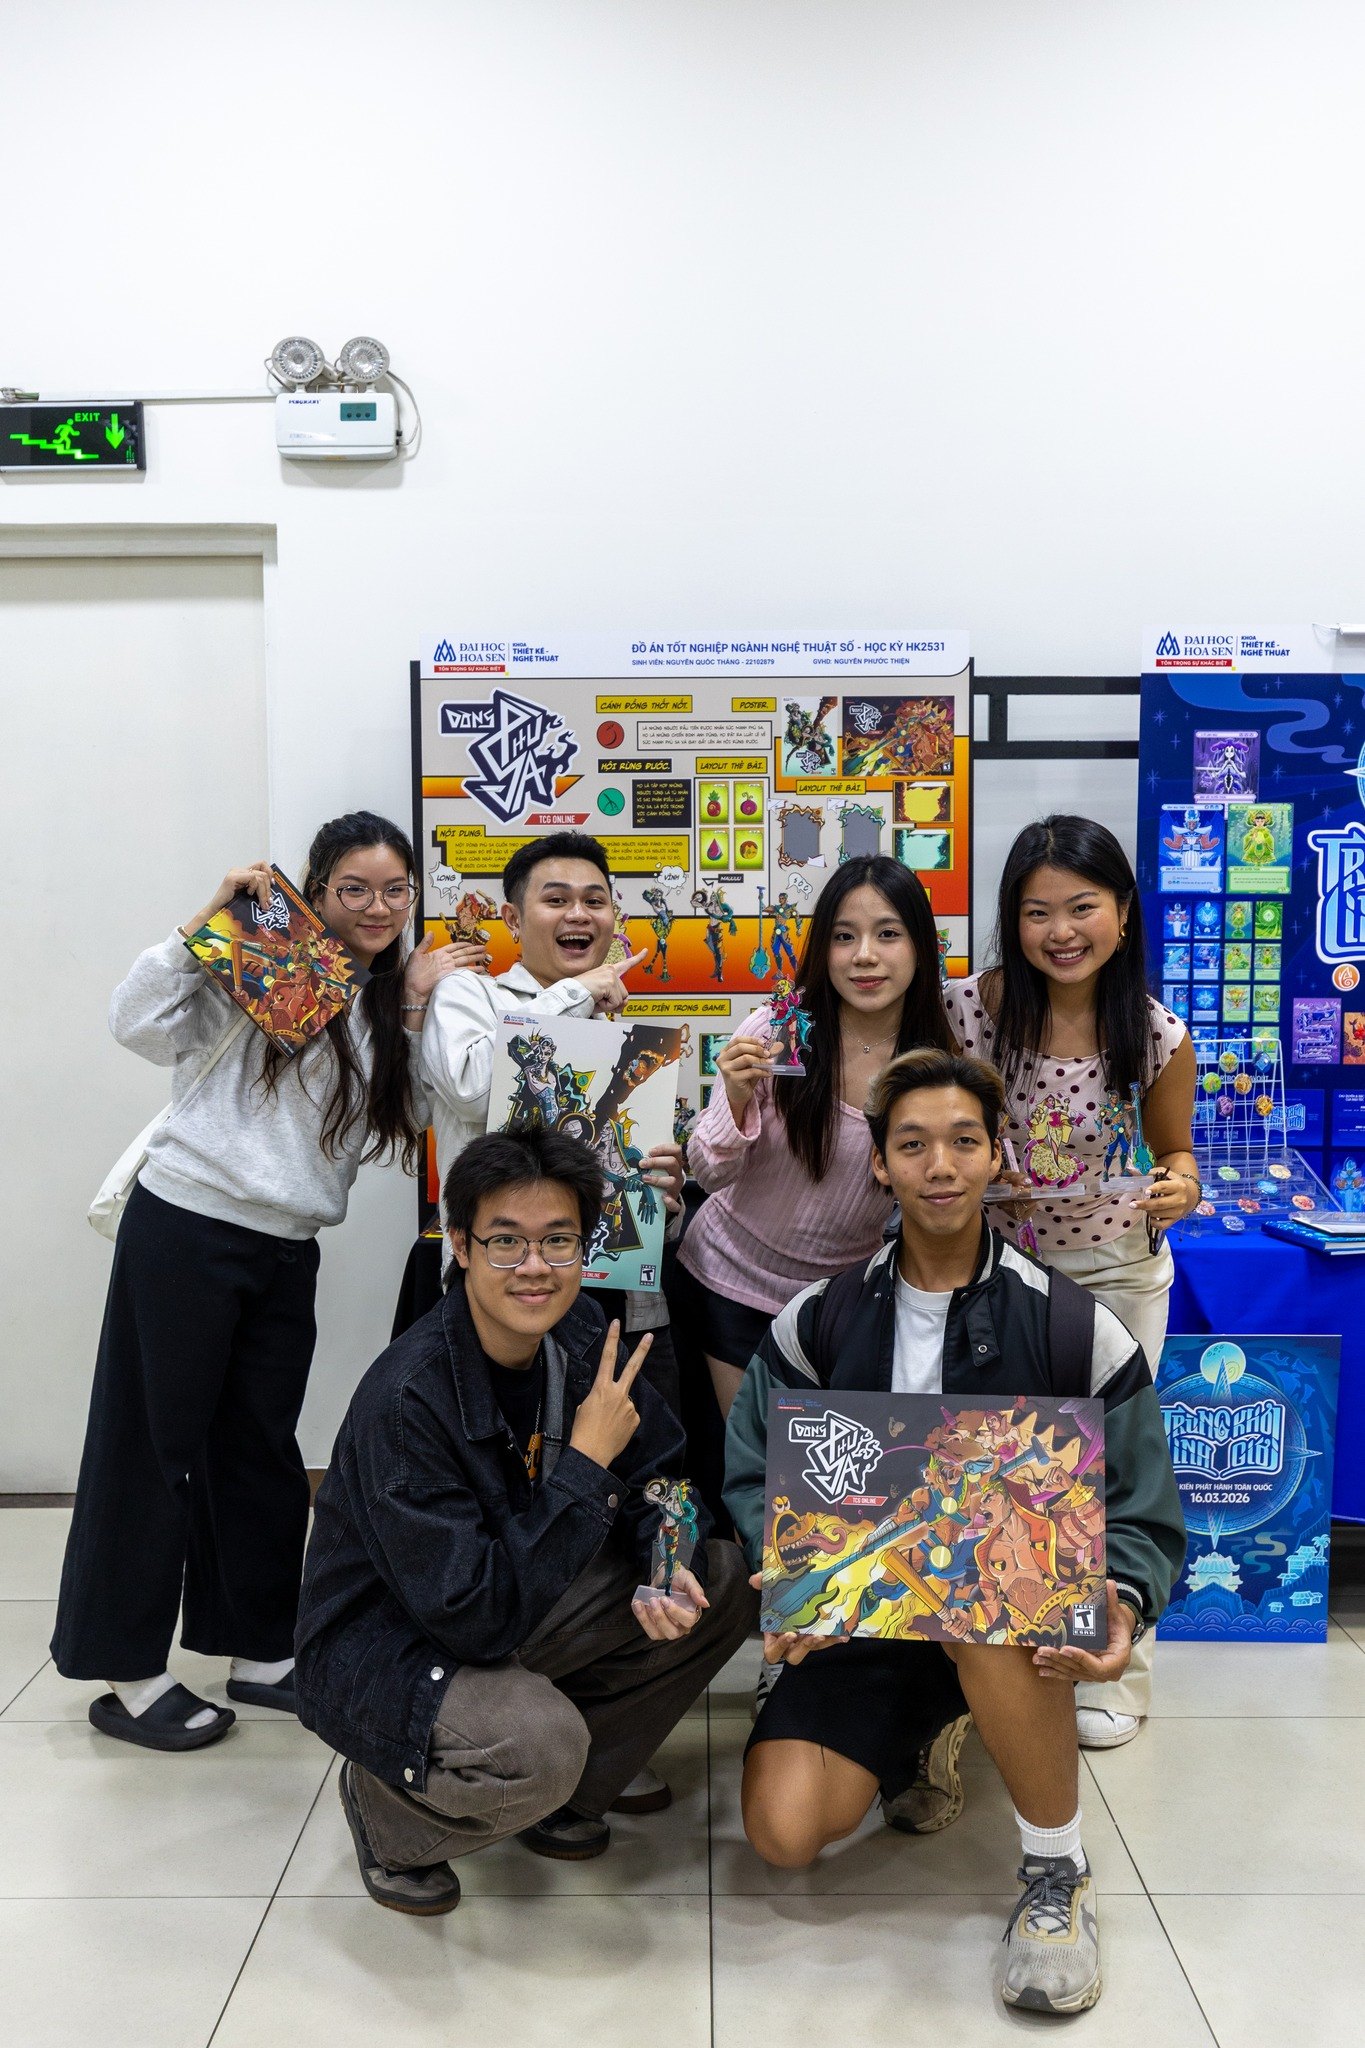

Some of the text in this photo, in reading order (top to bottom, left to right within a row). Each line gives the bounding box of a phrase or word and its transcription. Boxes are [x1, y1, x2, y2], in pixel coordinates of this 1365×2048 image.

[74, 413, 100, 421] EXIT
[632, 641, 646, 653] ĐỒ
[649, 642, 664, 652] ÁN
[667, 640, 686, 652] TỐT
[689, 643, 728, 654] NGHIỆP
[731, 641, 768, 652] NGÀNH
[771, 641, 800, 653] NGHỆ
[803, 641, 837, 653] THUẬT
[840, 640, 855, 652] SỐ
[864, 643, 887, 653] HỌC
[889, 640, 903, 651] KỲ
[906, 642, 945, 651] HK2531
[1184, 646, 1233, 656] HOA SEN
[460, 653, 506, 662] HOA SEN
[739, 701, 769, 709] POSTER.
[539, 815, 575, 824] TCG ONLINE
[626, 1003, 726, 1012] GIAO DIỆN TRONG GAME.
[643, 1269, 653, 1280] T
[861, 1497, 877, 1505] ONLINE
[1190, 1492, 1251, 1503] 16.03.2026
[1076, 1610, 1092, 1628] T
